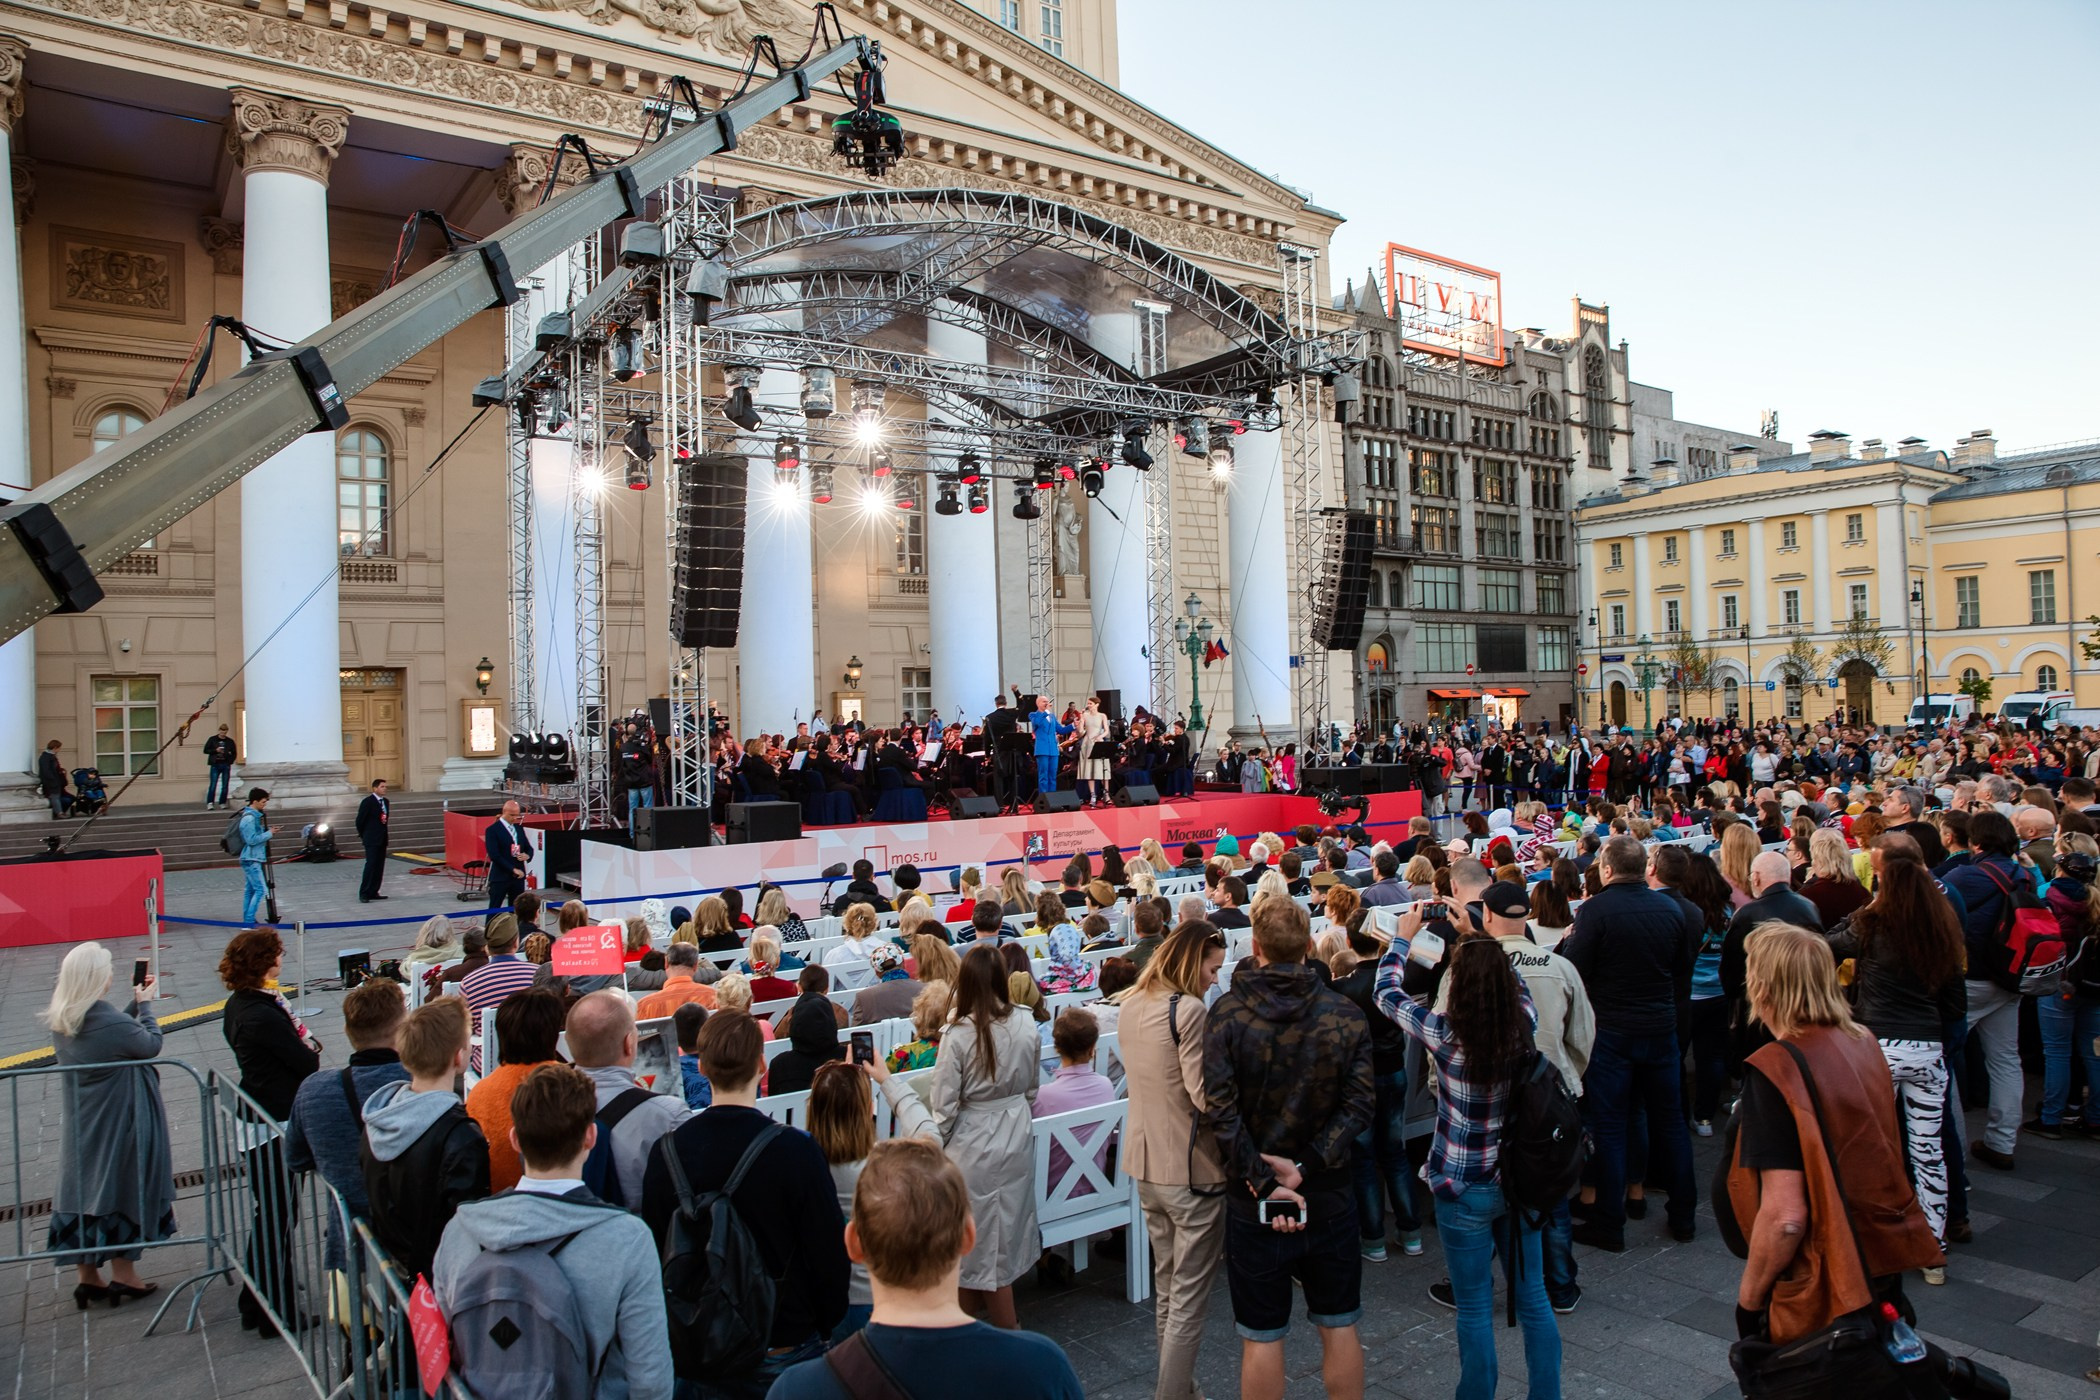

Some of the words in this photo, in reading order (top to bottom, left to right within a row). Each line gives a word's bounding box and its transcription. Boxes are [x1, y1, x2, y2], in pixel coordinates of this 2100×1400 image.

[1053, 828, 1095, 838] Департамент
[1166, 828, 1213, 842] Москва
[1215, 827, 1228, 838] 24
[1053, 839, 1083, 848] культуры
[891, 851, 937, 865] mos.ru
[1508, 951, 1550, 967] Diesel
[2023, 956, 2066, 978] FOX
